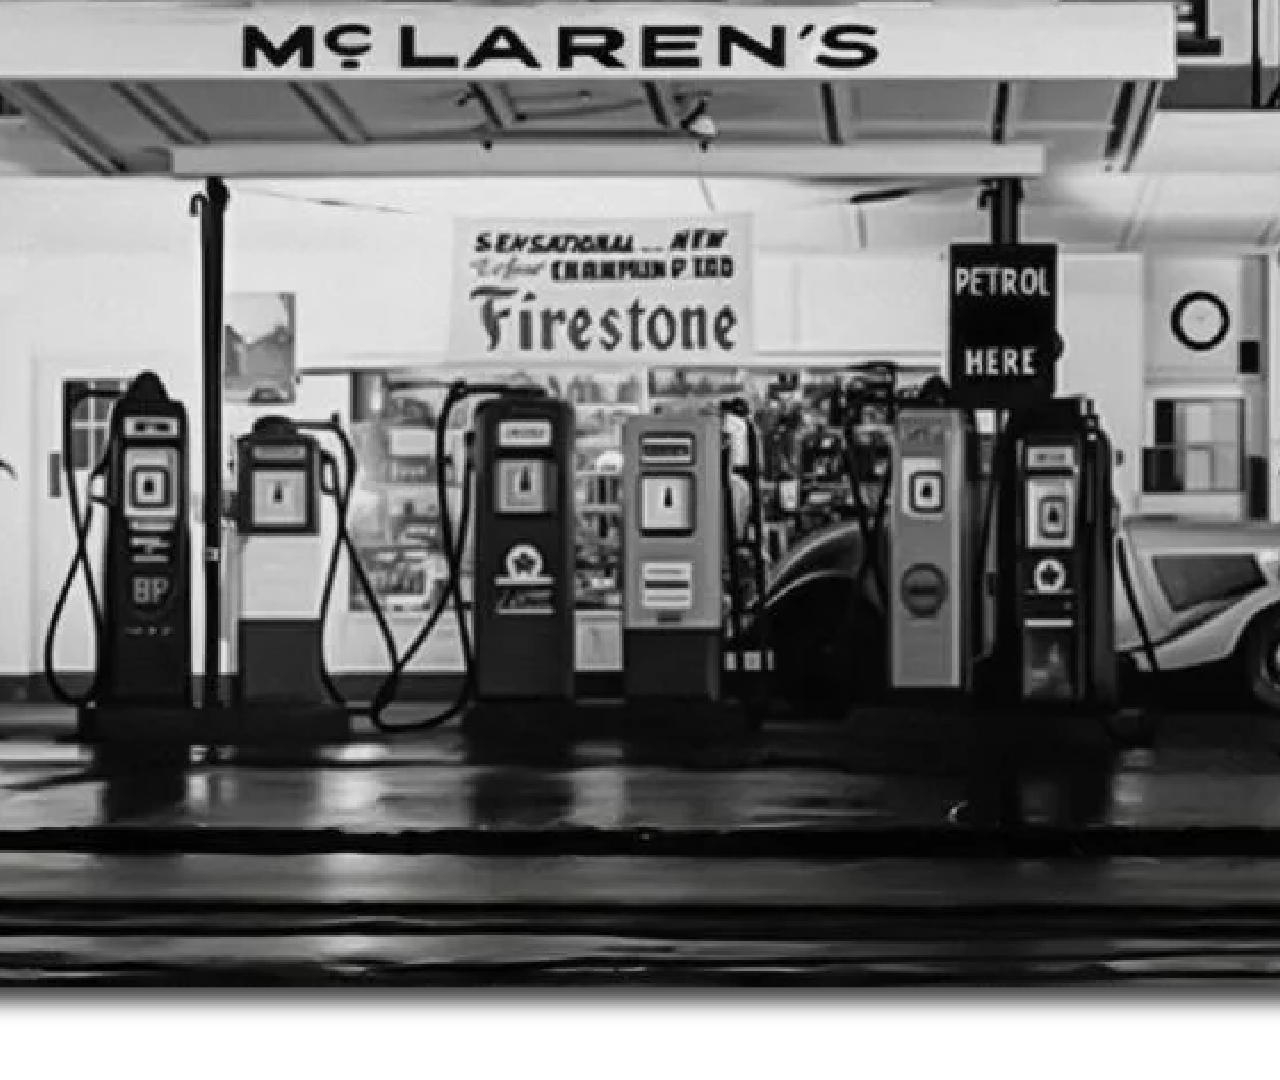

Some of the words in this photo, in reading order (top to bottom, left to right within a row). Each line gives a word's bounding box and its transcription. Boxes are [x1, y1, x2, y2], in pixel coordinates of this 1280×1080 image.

[474, 231, 634, 253] SENSATIONAL
[955, 266, 1051, 298] PETROL
[469, 286, 737, 352] Firestone
[964, 346, 1037, 376] HERE
[133, 576, 168, 604] BP
